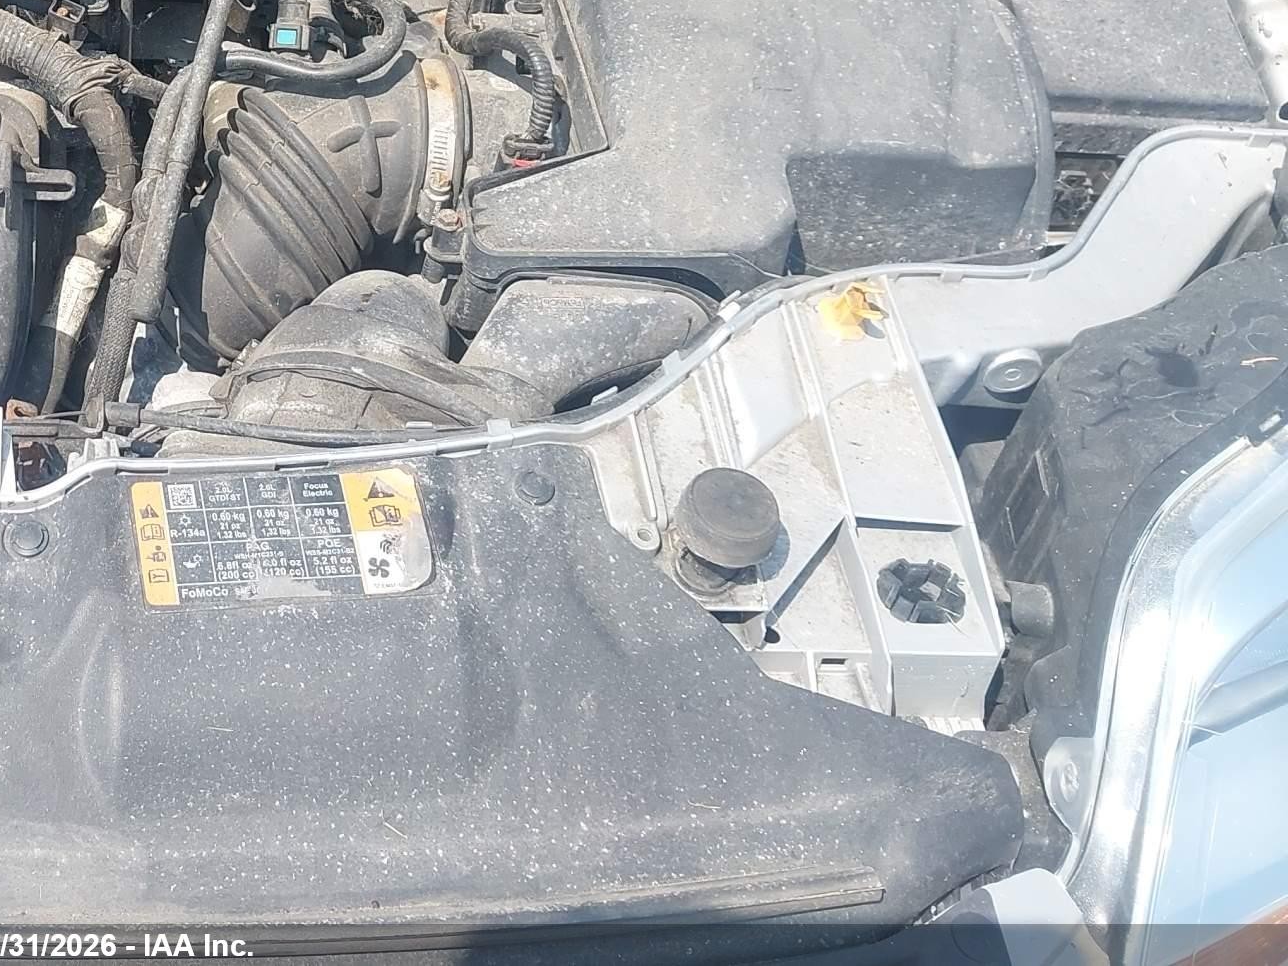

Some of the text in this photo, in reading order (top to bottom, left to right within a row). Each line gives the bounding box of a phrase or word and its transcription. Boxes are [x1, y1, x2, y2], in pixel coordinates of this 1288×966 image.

[303, 482, 329, 490] Focus
[261, 491, 277, 499] GDI
[233, 512, 246, 523] kg
[256, 508, 290, 520] 0.60 kg
[306, 507, 339, 518] 0.60 kg
[170, 528, 206, 538] R-134a
[317, 538, 342, 548] POE
[313, 557, 328, 565] 5.2
[315, 564, 355, 577] (155 cc)
[181, 586, 229, 599] FoMoCo
